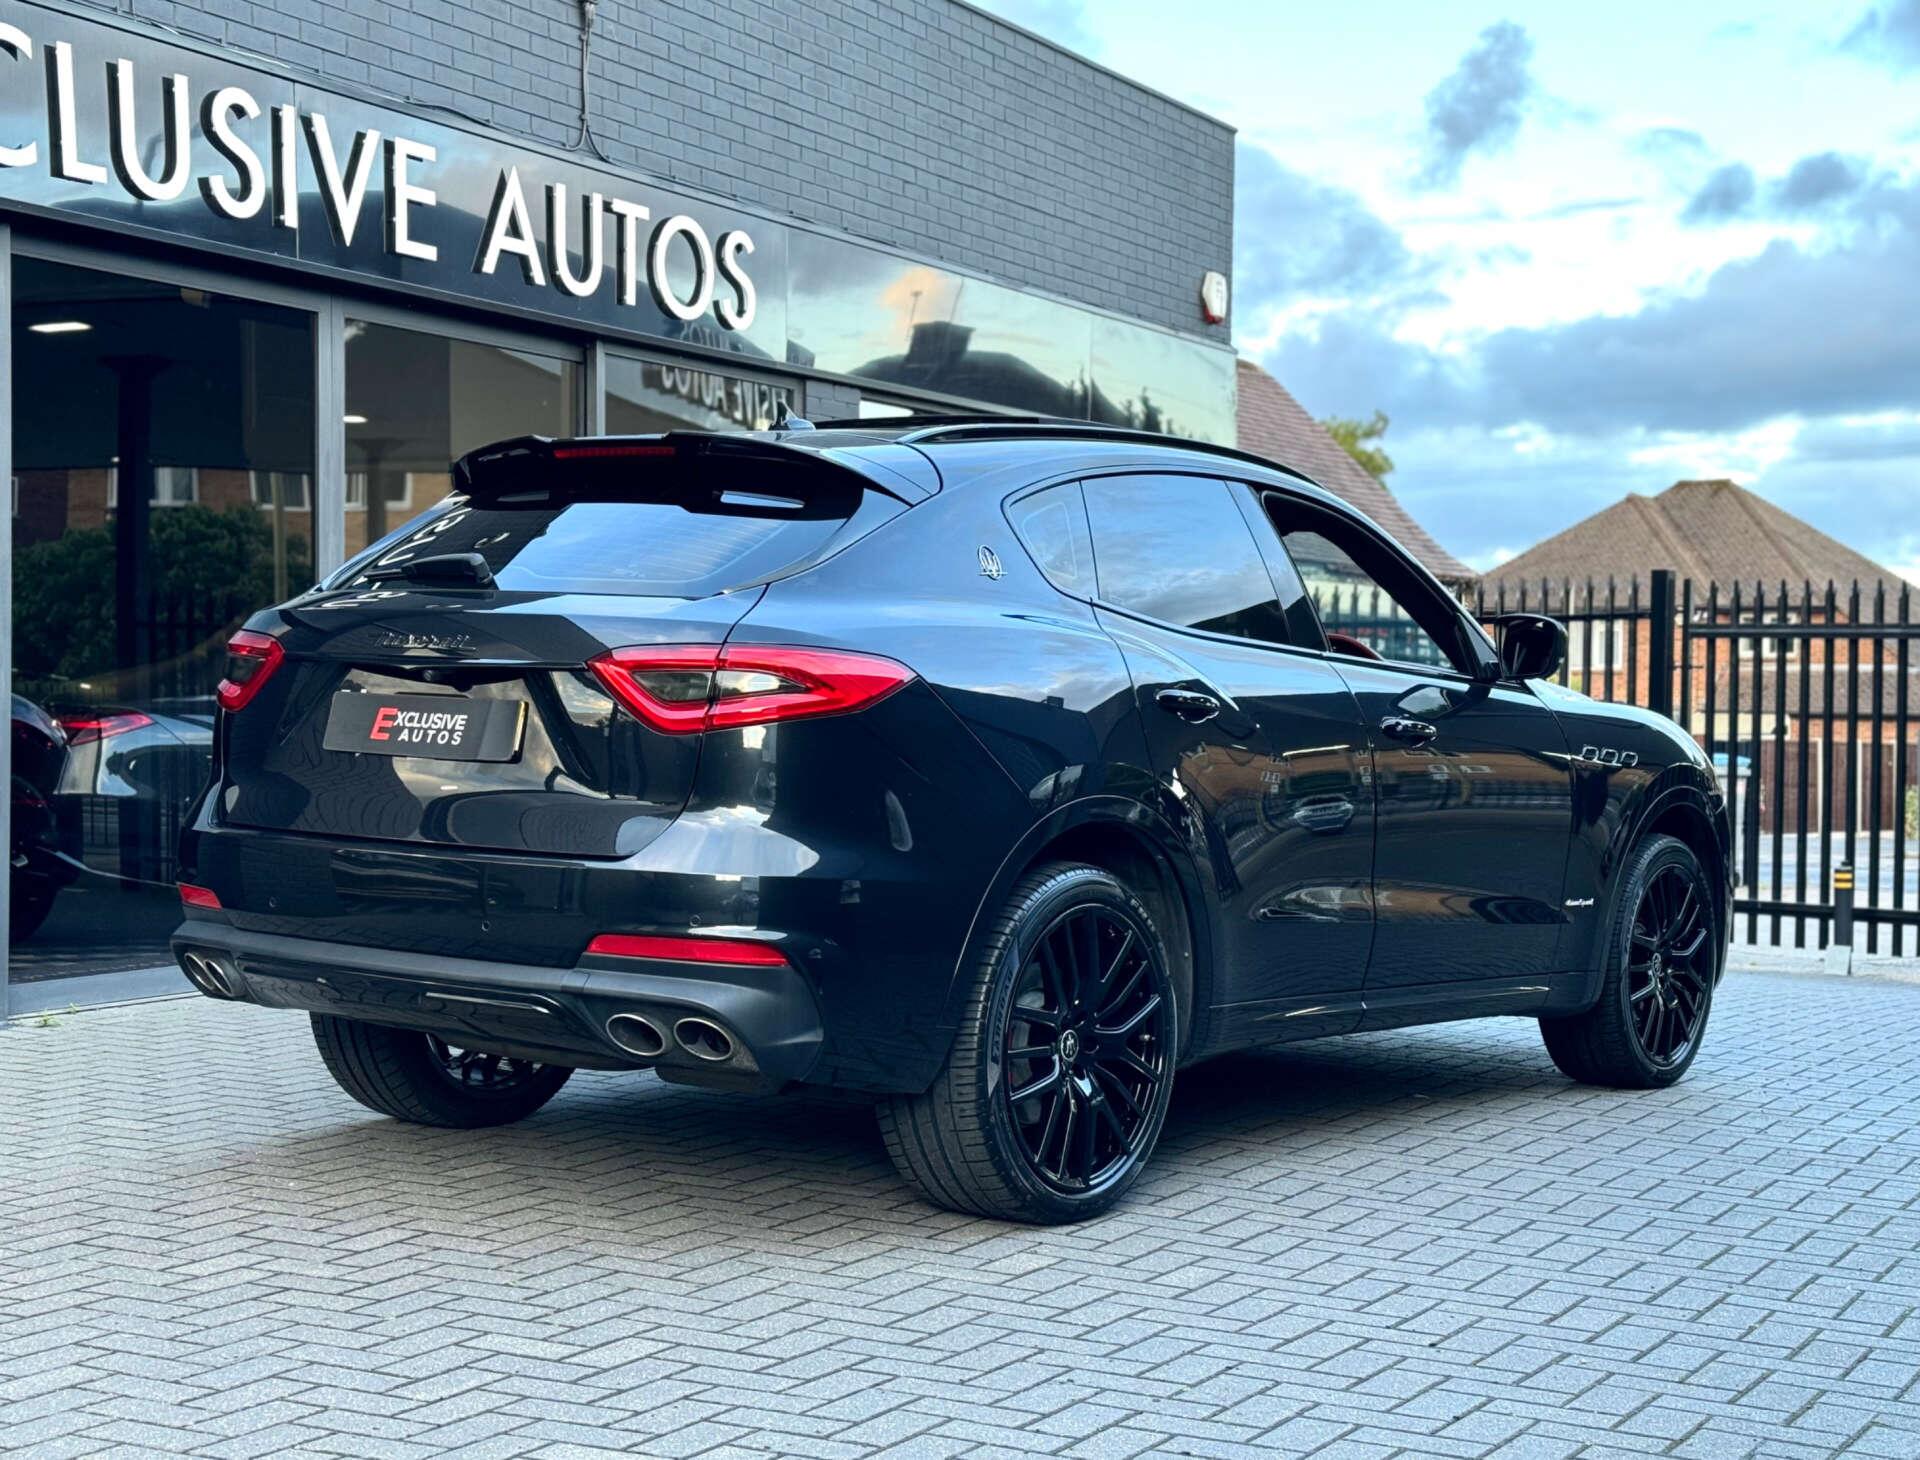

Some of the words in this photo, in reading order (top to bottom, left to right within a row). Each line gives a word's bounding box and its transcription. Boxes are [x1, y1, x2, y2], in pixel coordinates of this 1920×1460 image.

[475, 165, 757, 332] AUTOS
[369, 707, 468, 740] EXCLUSIVE
[397, 728, 463, 746] AUTOS
